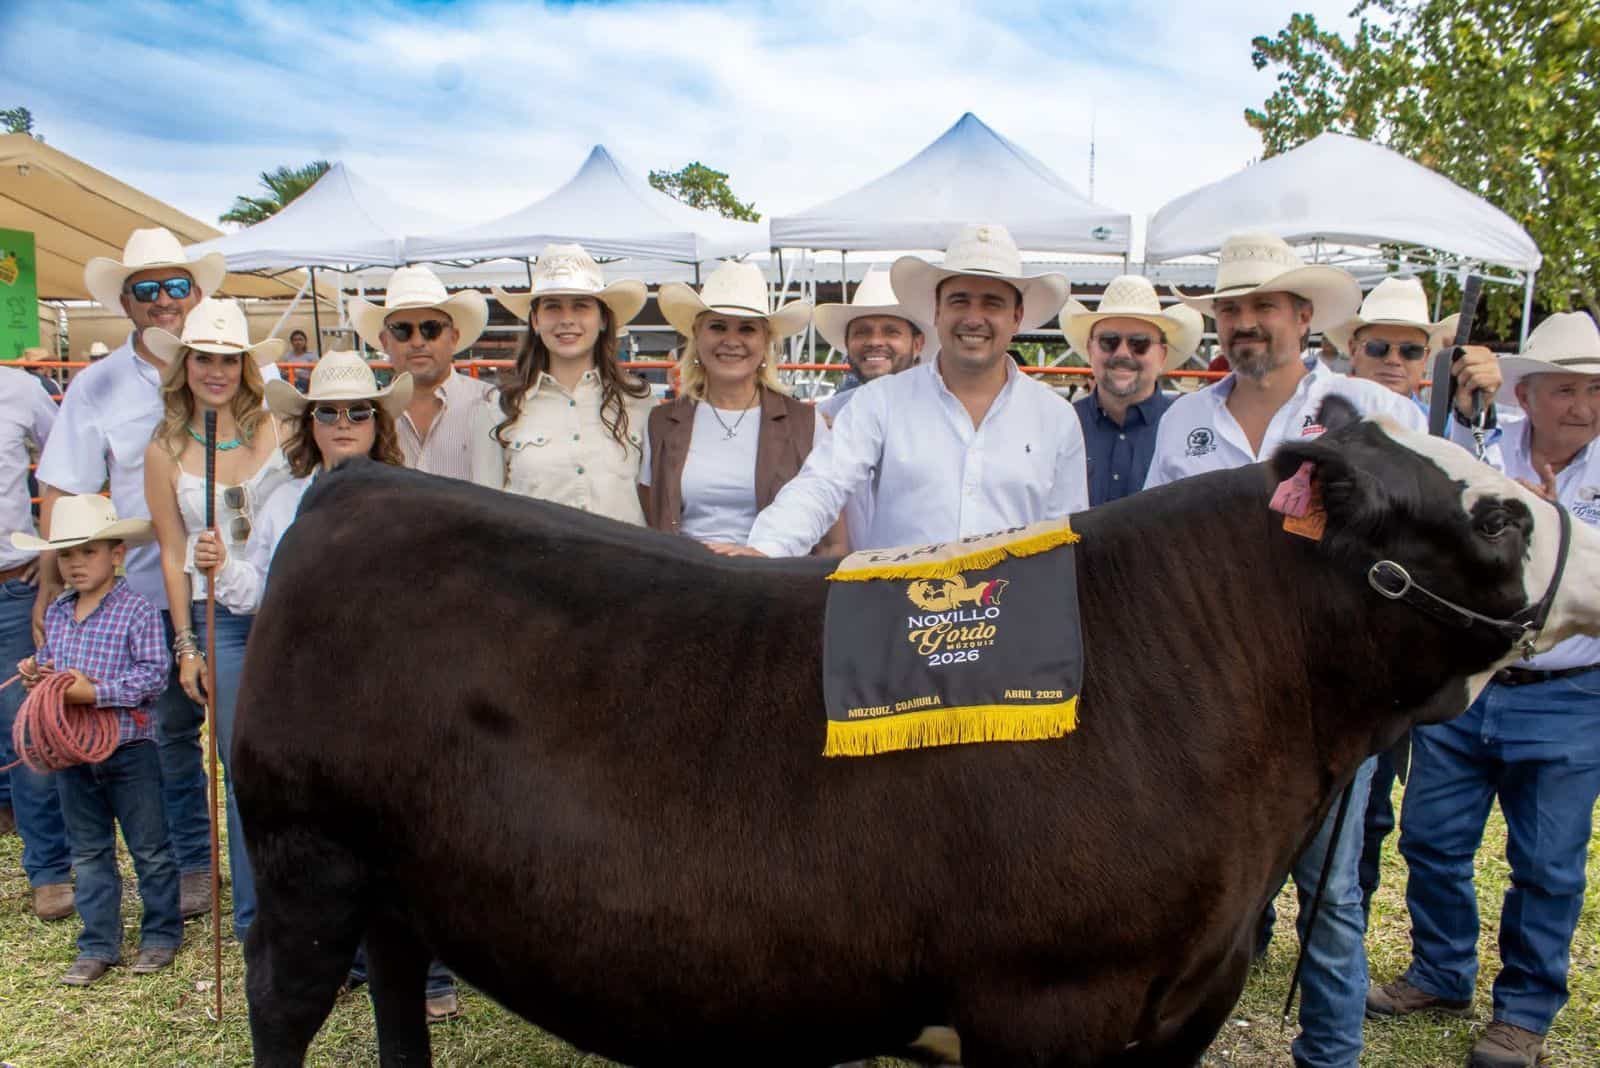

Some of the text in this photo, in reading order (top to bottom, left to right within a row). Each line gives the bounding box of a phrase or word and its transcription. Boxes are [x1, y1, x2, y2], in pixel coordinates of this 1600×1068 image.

[908, 607, 1000, 629] NOVILLO
[908, 621, 997, 655] Gordo
[928, 649, 980, 667] 2026
[895, 695, 942, 712] COAHUILA
